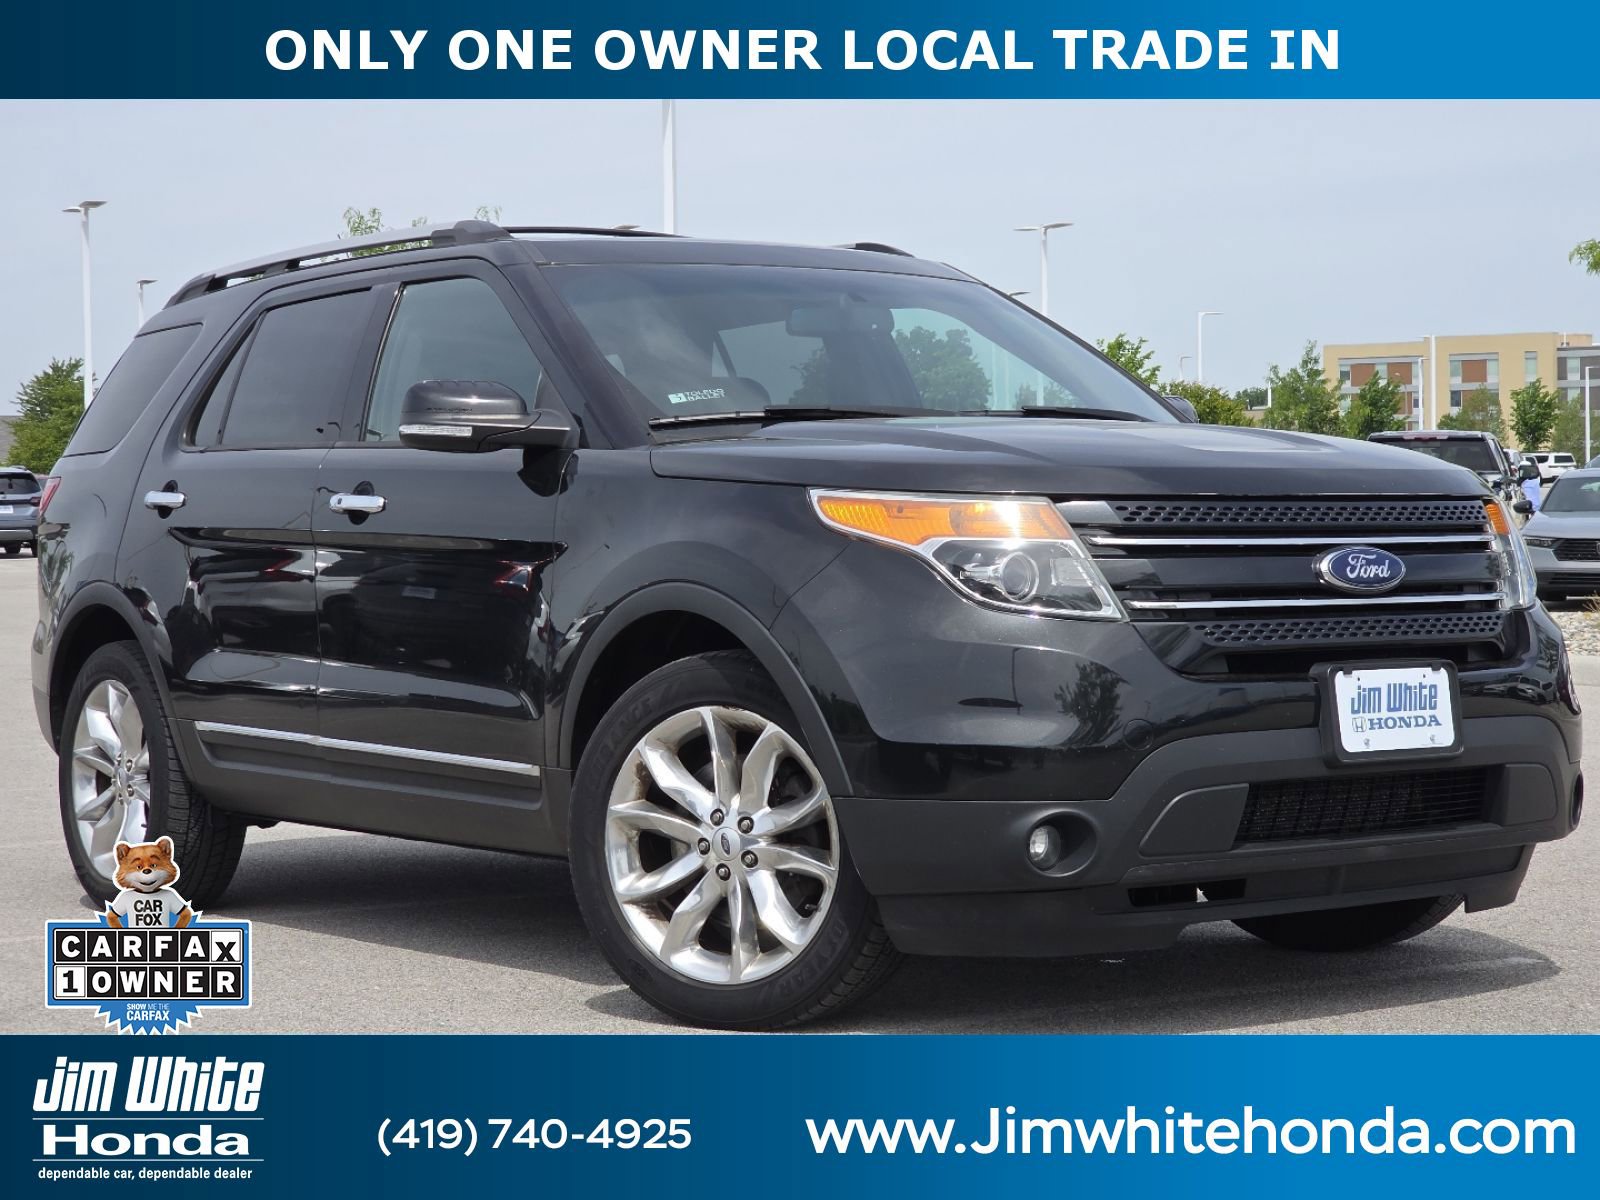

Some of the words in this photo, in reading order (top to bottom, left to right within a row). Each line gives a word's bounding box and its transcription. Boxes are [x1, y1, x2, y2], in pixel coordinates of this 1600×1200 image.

[1346, 553, 1391, 579] Ford
[1350, 684, 1382, 715] Jim
[1386, 681, 1438, 713] White
[1368, 714, 1442, 731] HONDA
